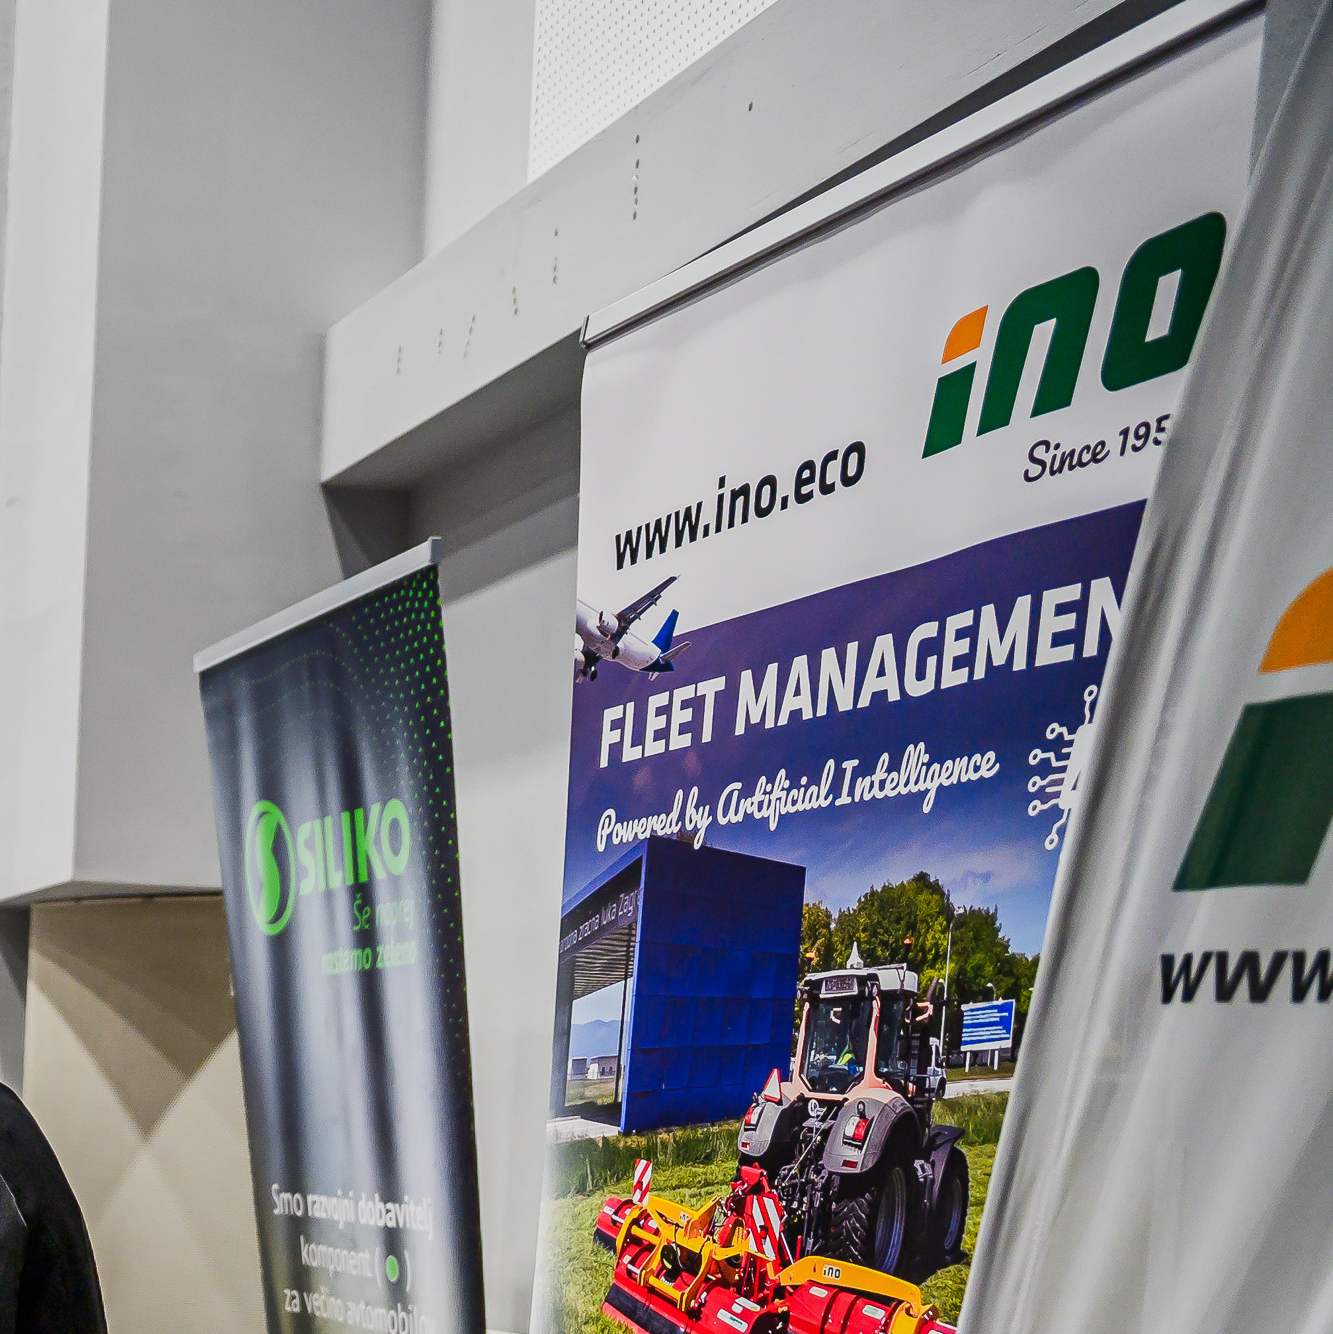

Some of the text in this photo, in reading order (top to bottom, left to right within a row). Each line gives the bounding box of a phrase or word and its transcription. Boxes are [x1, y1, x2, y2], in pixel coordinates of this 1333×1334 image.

[922, 211, 1226, 459] ino
[1023, 413, 1171, 483] Since 195
[614, 441, 865, 571] www.ino.eco
[599, 576, 1124, 768] FLEET MANAGEMEN
[296, 798, 411, 896] SILIKO
[596, 743, 1000, 853] Powered by Artificial Intelligence
[271, 1183, 303, 1216] Smo
[358, 1192, 433, 1240] dobavitelj
[299, 1235, 372, 1279] komponent
[283, 1289, 300, 1313] za
